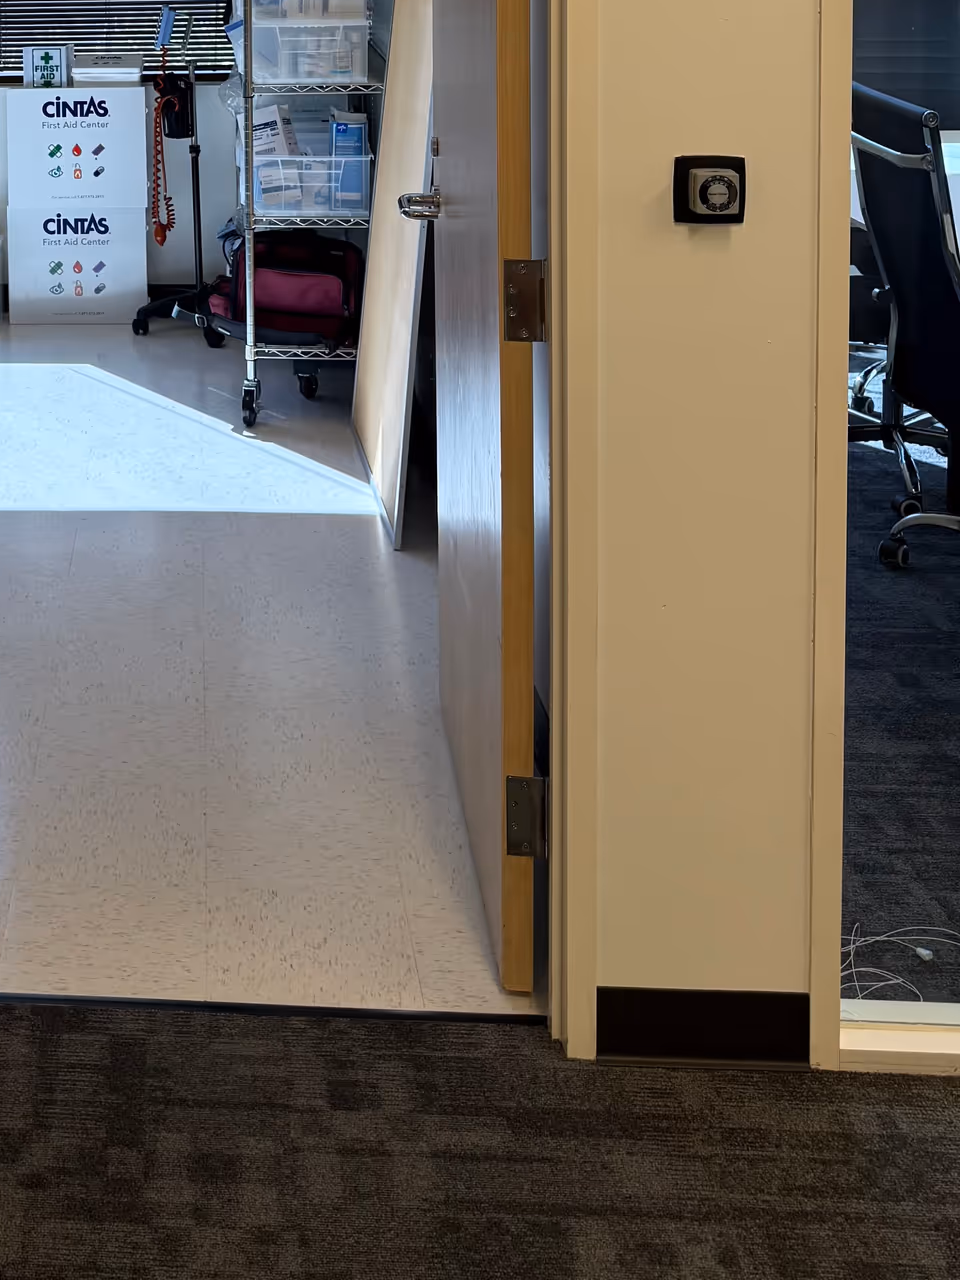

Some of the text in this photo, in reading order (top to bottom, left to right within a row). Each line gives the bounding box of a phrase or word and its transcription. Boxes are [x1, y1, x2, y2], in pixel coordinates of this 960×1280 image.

[35, 65, 60, 73] FIRST
[42, 121, 110, 129] First Aid Center
[43, 238, 110, 246] First Aid Center
